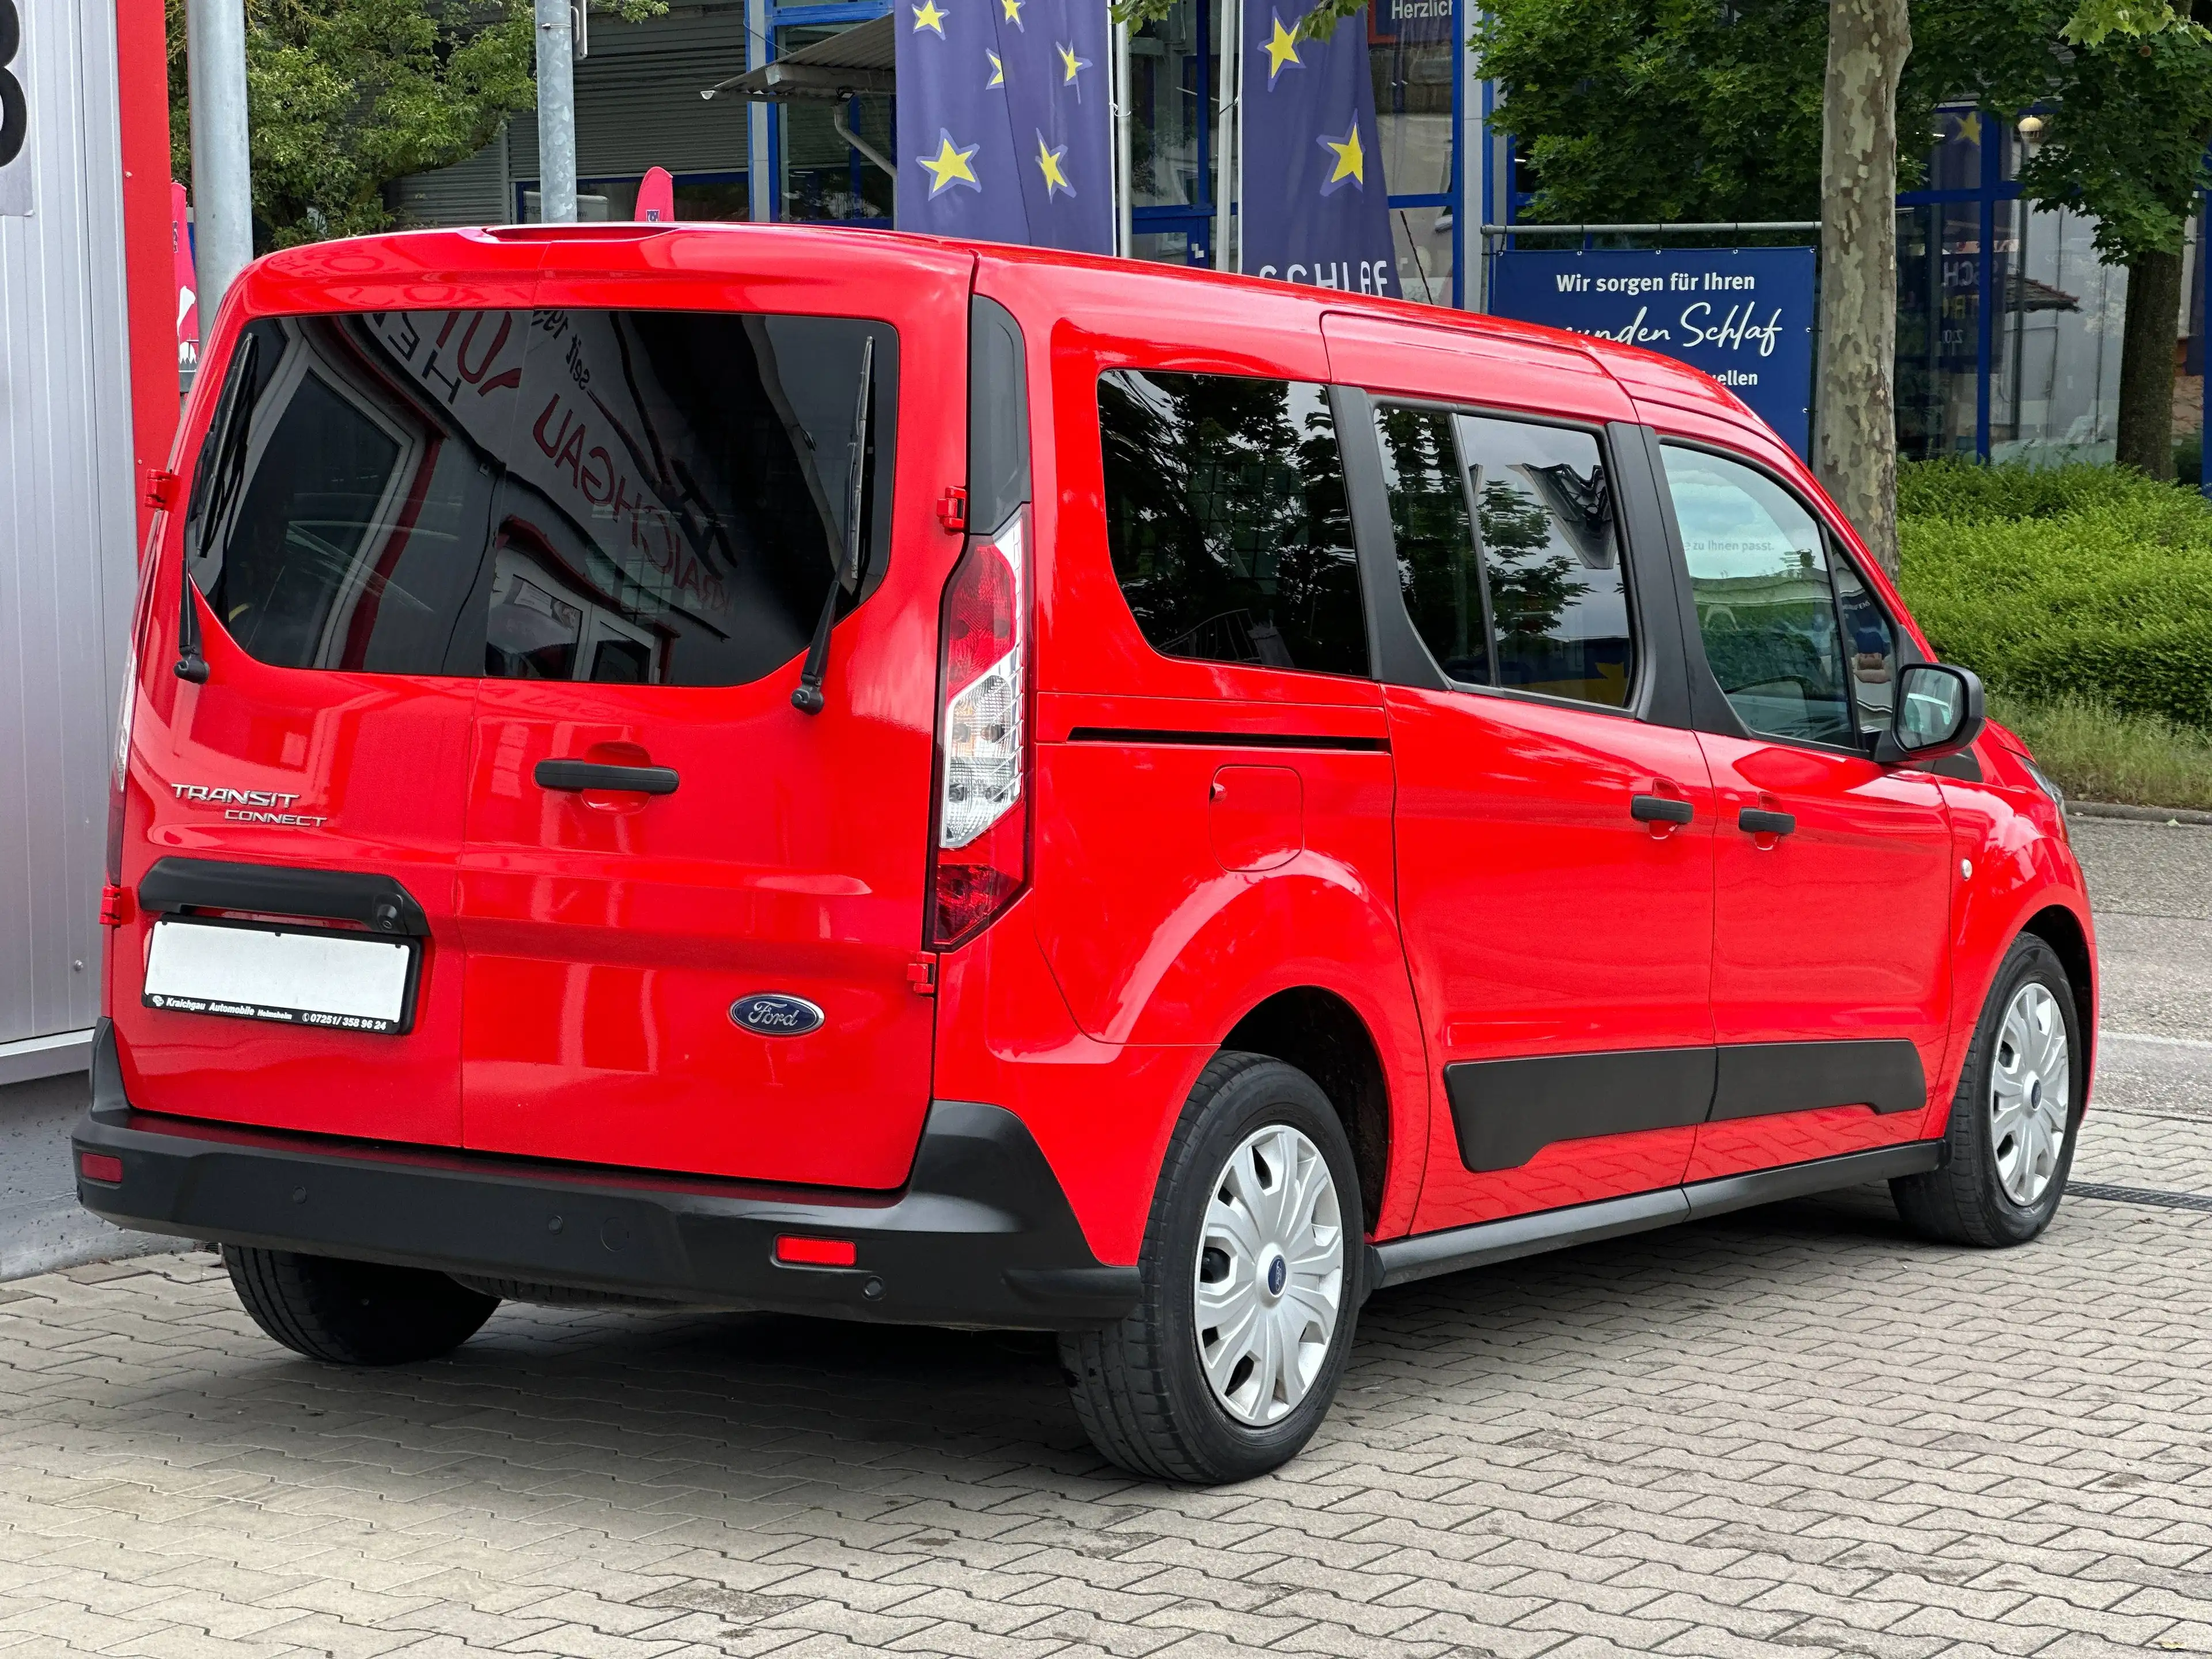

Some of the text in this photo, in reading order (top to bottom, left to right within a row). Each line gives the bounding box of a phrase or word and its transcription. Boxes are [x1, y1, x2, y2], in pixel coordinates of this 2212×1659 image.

[1556, 272, 1755, 296] Wir sorgen für Ihren
[1680, 301, 1783, 357] Schlaf
[1694, 541, 1705, 551] zu
[1708, 540, 1738, 551] Ihnen
[1742, 541, 1775, 552] passt.
[171, 783, 301, 808] TRANSIT
[224, 809, 328, 828] CONNECT
[166, 997, 206, 1011] Kraichgau
[209, 1002, 255, 1016] Automobile
[310, 1013, 342, 1025] 07251/
[342, 1017, 360, 1028] 358
[361, 1019, 373, 1029] 96
[374, 1020, 387, 1031] 24
[748, 1001, 800, 1026] Ford
